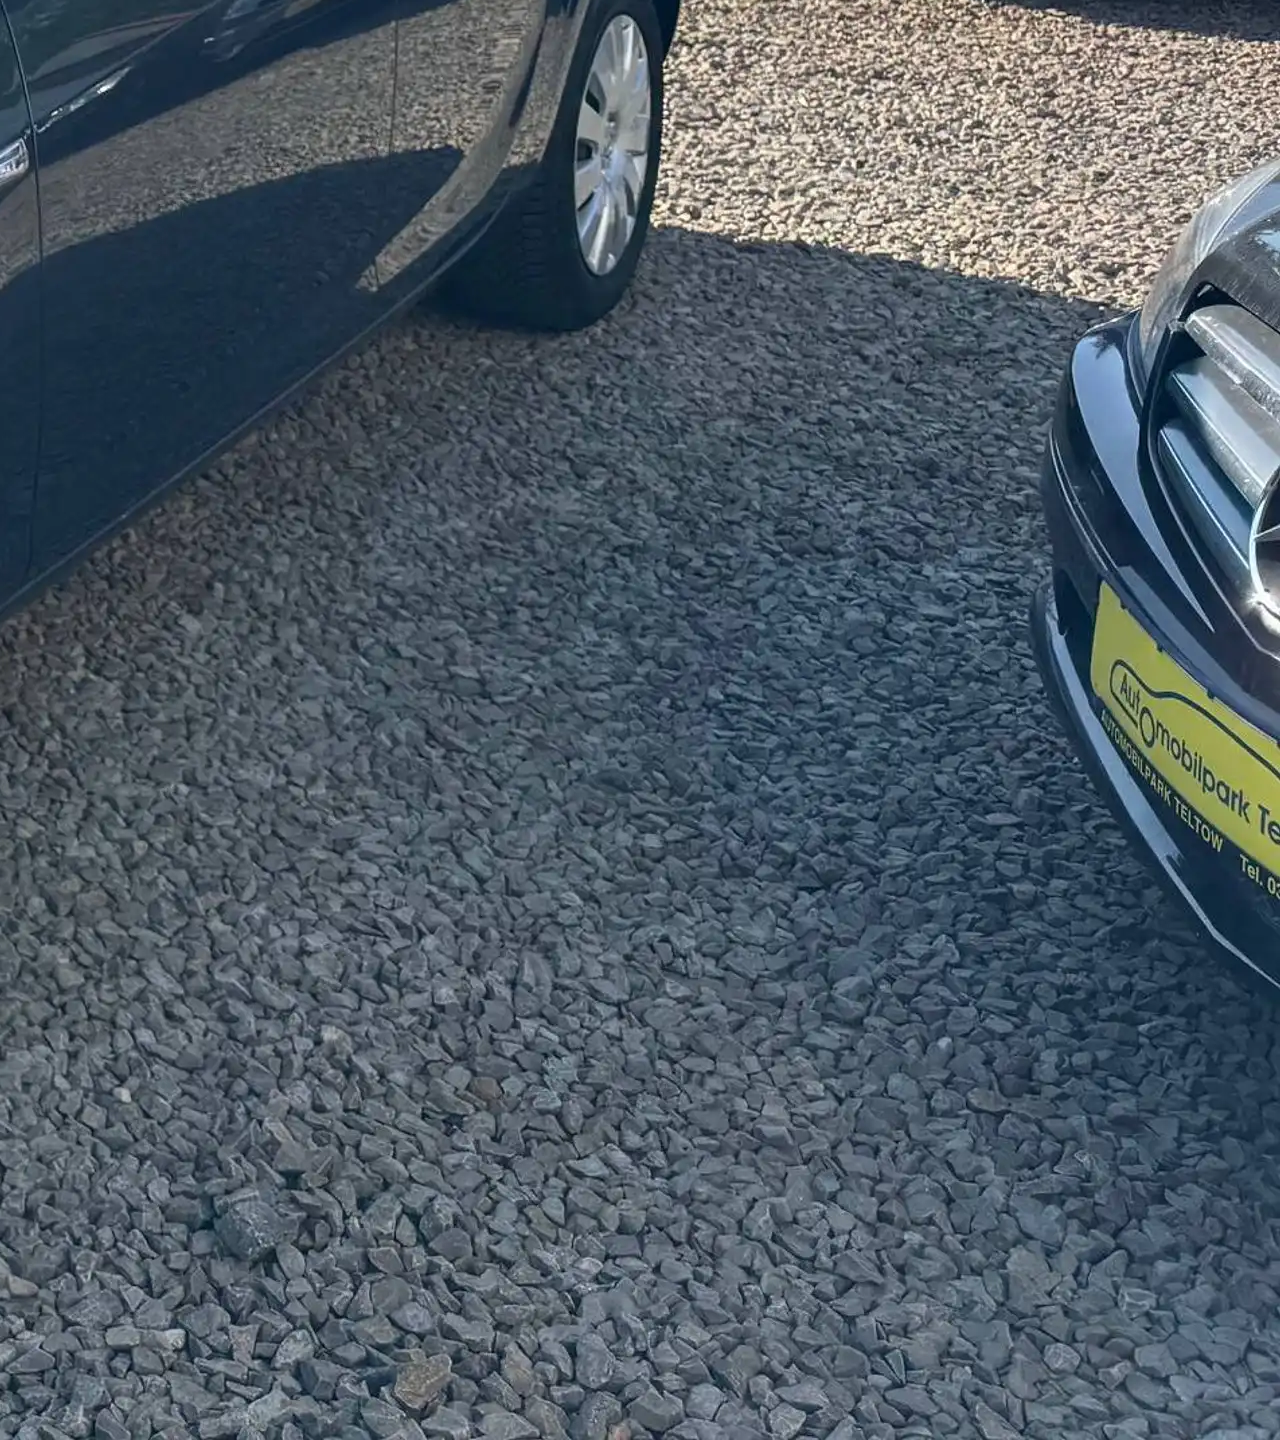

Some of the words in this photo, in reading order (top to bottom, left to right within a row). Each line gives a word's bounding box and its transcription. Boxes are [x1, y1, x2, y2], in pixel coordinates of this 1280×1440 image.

[1100, 708, 1173, 807] AUTOMOBILPARK
[1173, 795, 1225, 853] TELTOW
[1239, 853, 1264, 887] Tel.
